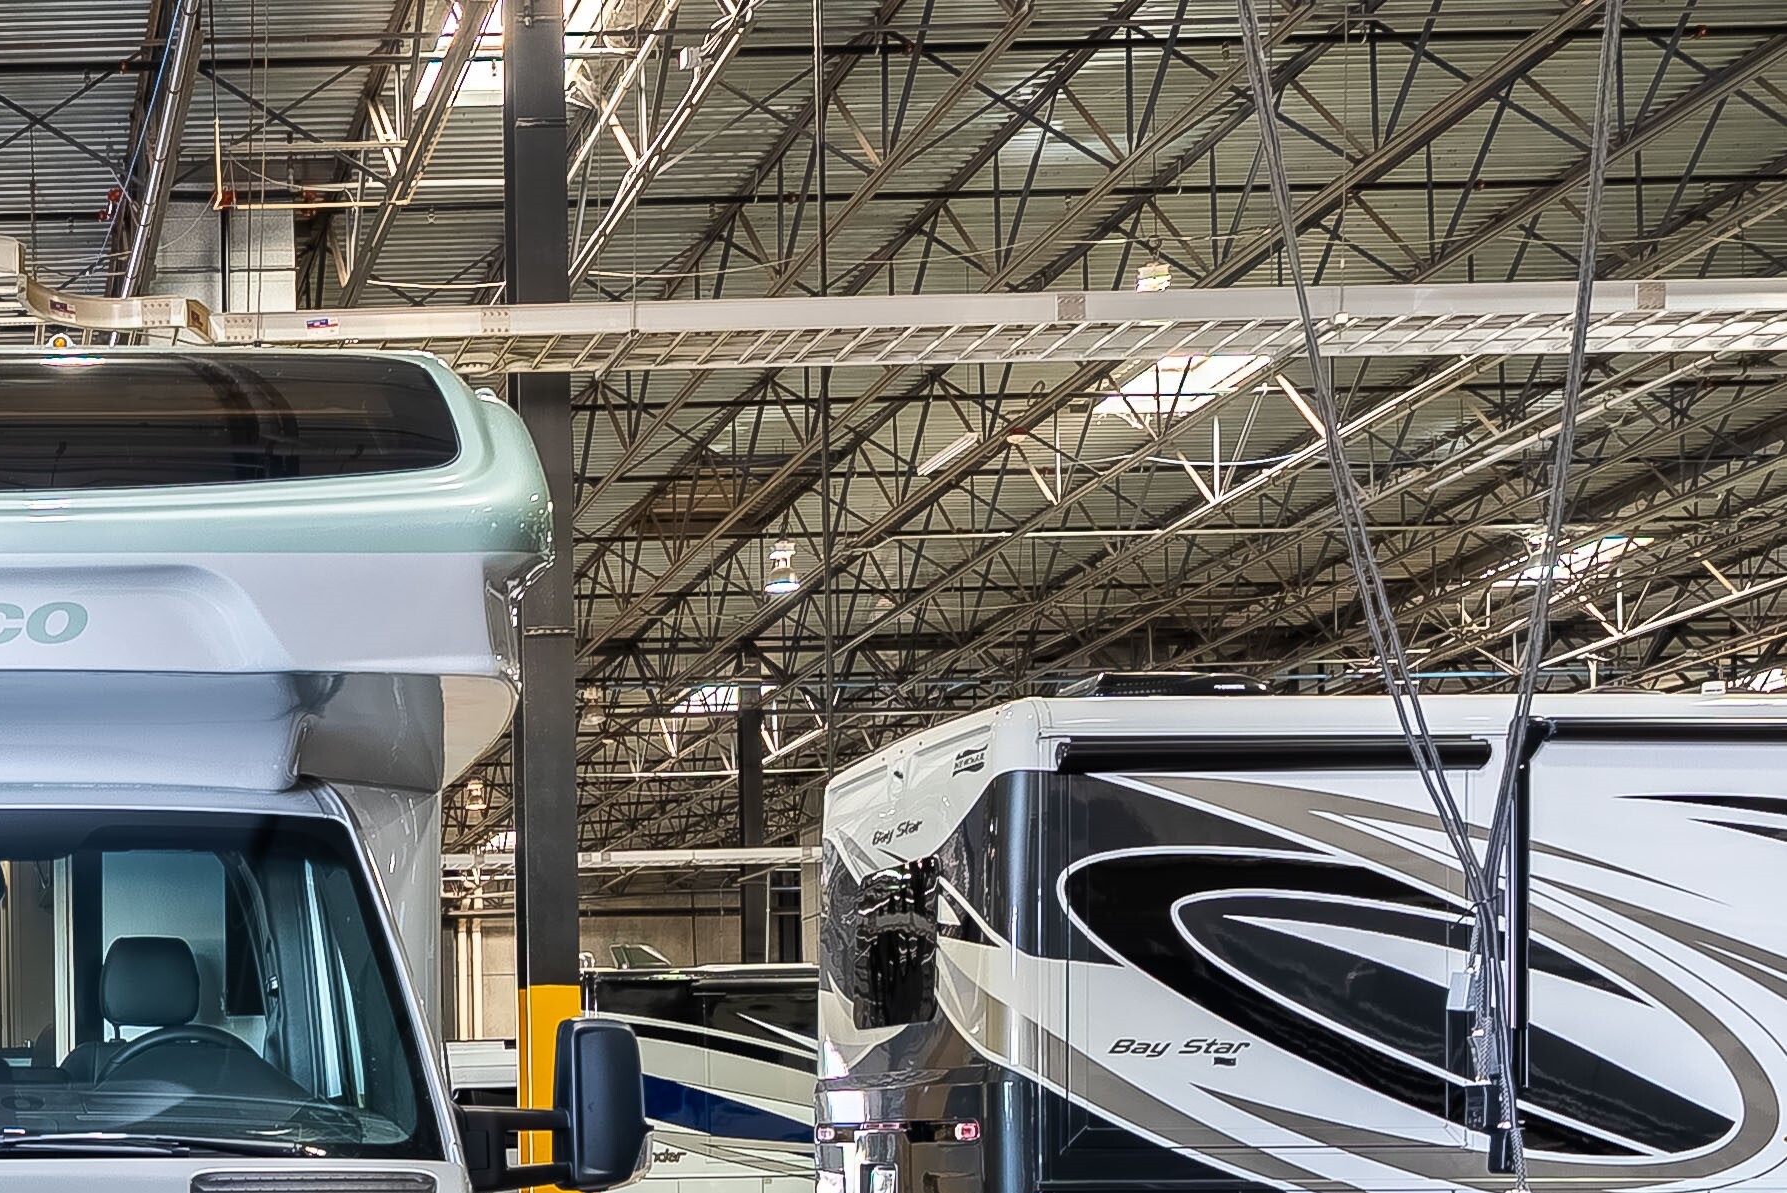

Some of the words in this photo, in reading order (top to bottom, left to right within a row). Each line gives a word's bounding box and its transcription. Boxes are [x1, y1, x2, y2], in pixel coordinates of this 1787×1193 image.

[872, 829, 895, 846] Bay
[895, 819, 923, 838] Star
[1108, 1038, 1172, 1058] Bay
[1178, 1038, 1251, 1054] Star
